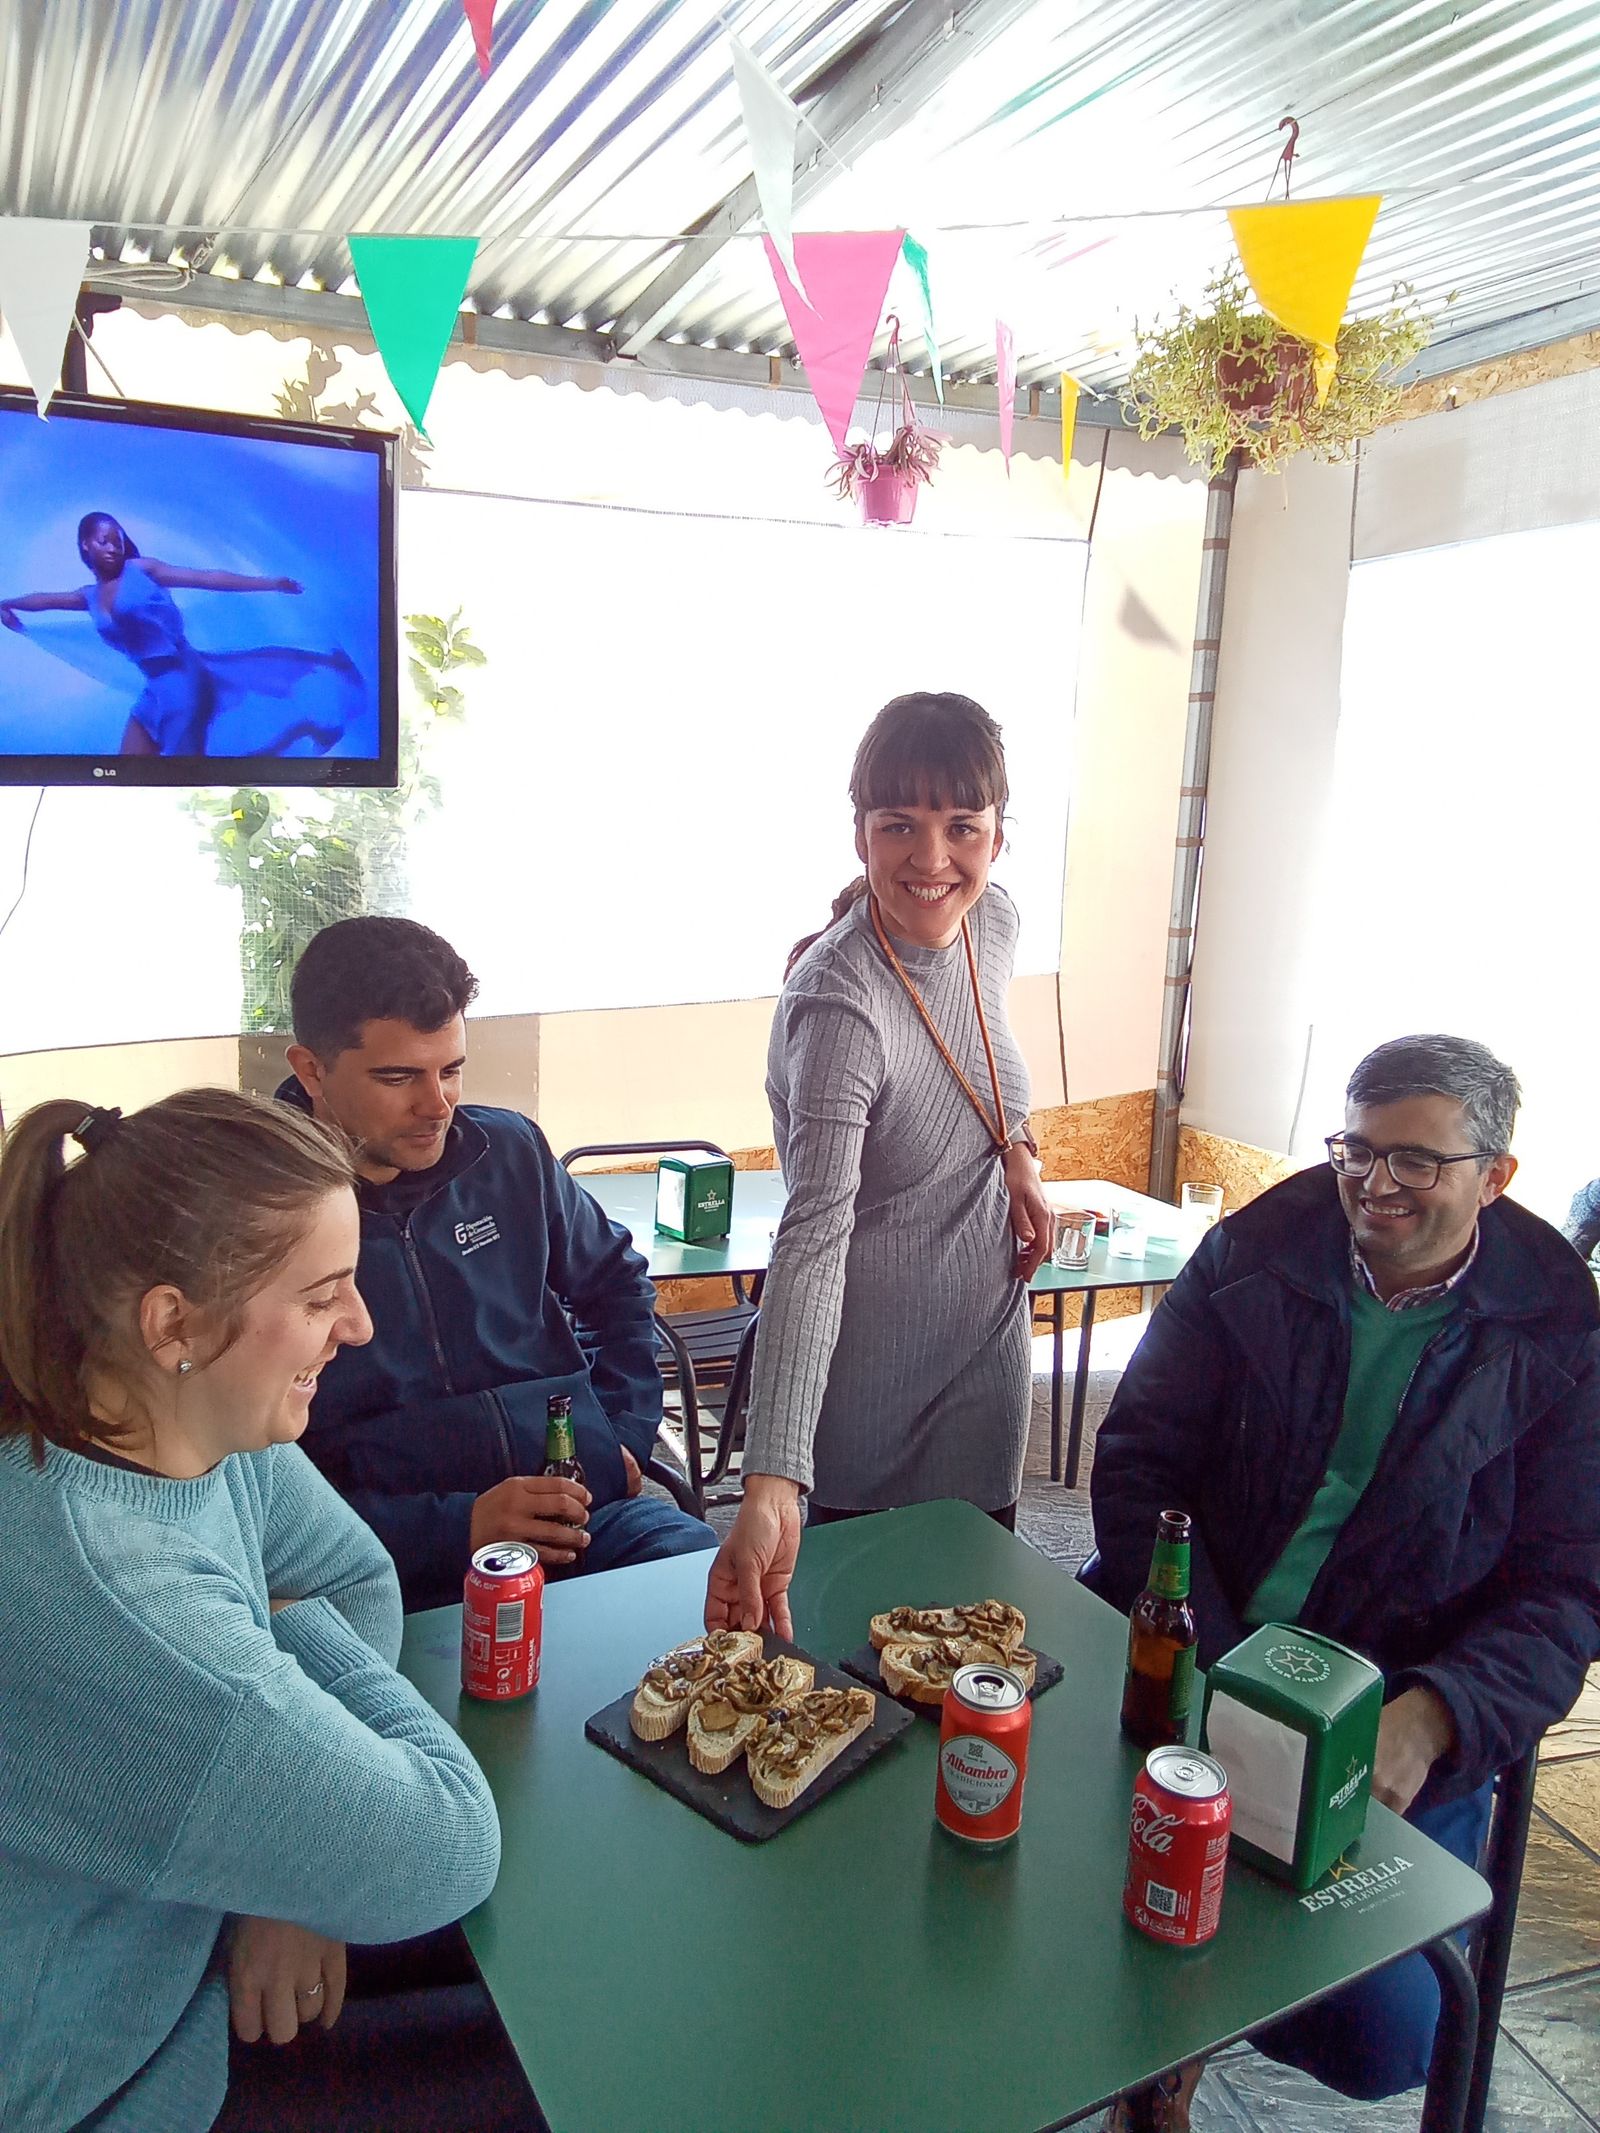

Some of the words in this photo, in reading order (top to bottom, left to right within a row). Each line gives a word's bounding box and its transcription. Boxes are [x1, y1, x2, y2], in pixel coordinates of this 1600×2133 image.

[945, 1752, 1009, 1780] Alhambra
[1329, 1763, 1368, 1809] ESTRELLA
[1298, 1855, 1415, 1913] ESTRELLA
[1340, 1898, 1357, 1909] DE
[1358, 1876, 1401, 1902] LEVANTE
